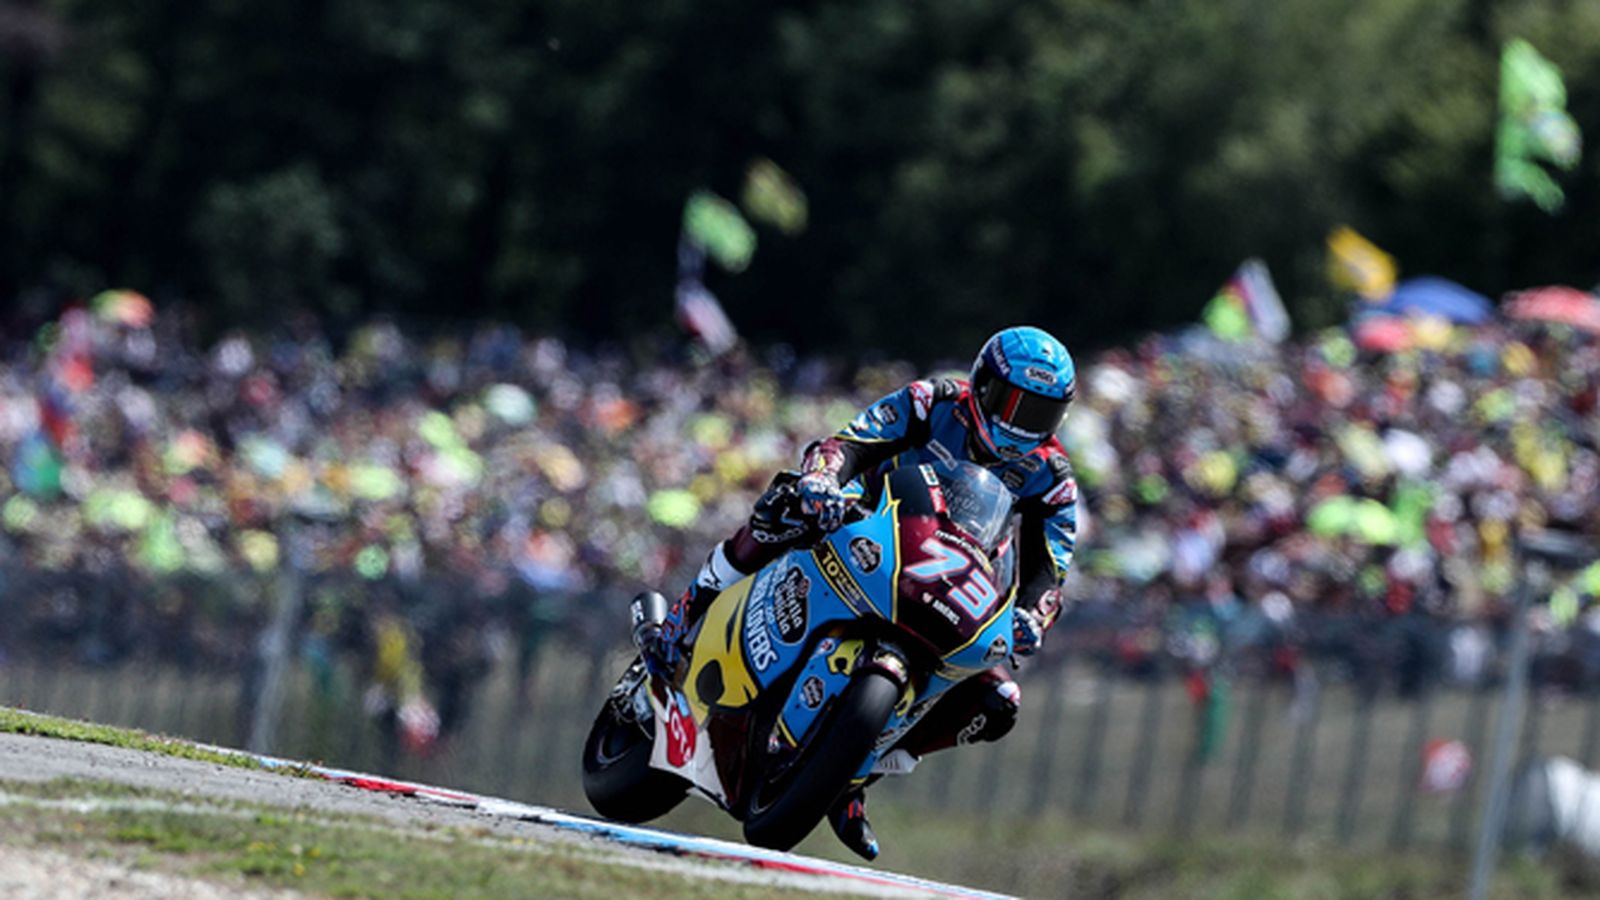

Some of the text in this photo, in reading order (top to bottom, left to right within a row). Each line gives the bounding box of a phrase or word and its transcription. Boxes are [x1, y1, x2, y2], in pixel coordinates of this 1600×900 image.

[820, 551, 841, 577] 10
[903, 536, 1000, 621] 73
[746, 599, 778, 672] LOVERS
